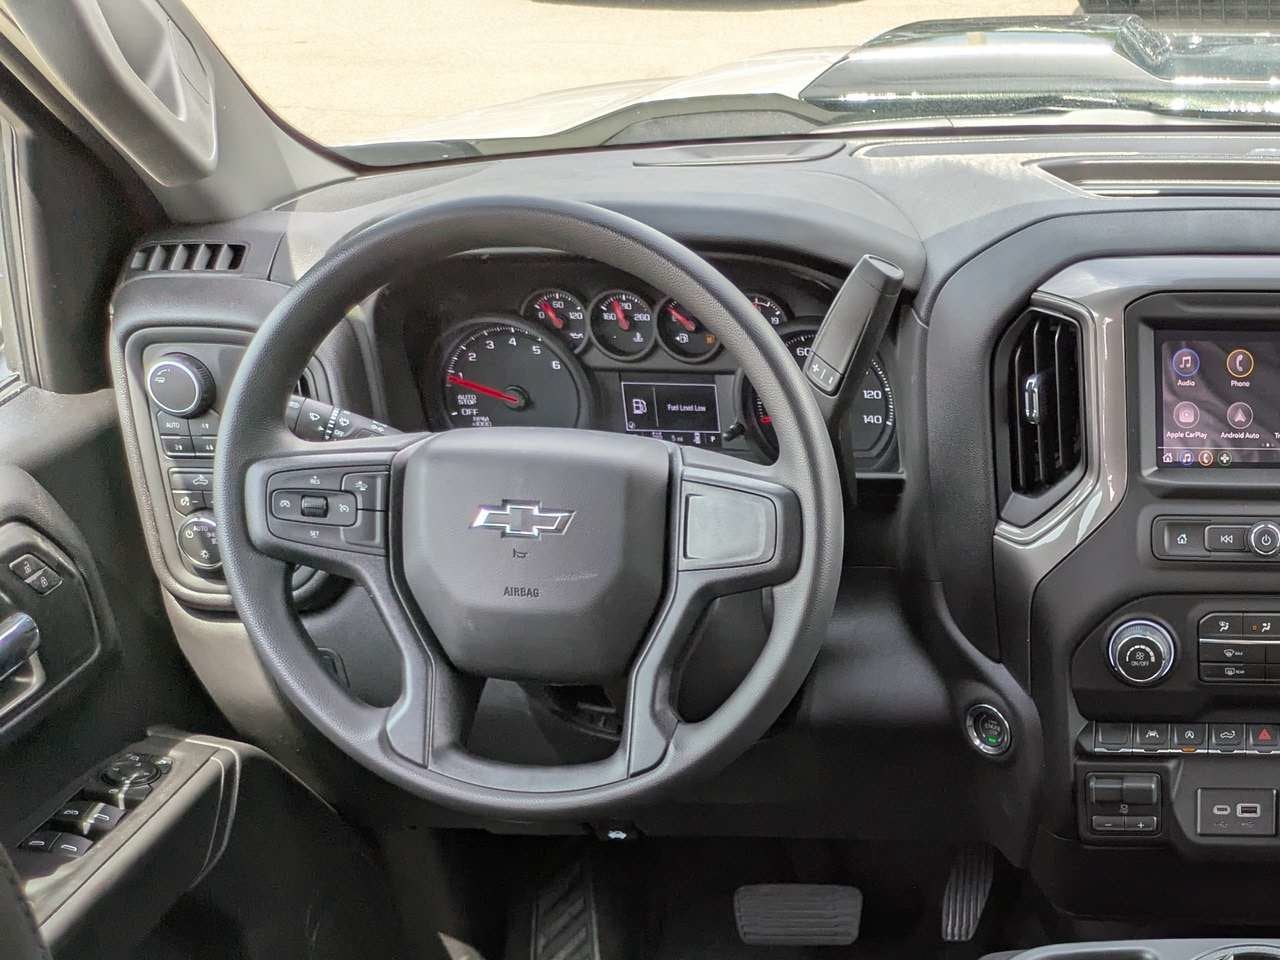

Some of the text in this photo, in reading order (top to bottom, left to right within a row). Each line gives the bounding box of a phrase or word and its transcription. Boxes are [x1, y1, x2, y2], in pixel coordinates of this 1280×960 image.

[569, 312, 583, 320] 120
[486, 340, 495, 349] 3
[508, 337, 517, 346] 4
[532, 345, 541, 355] 5
[468, 352, 477, 362] 2
[552, 361, 561, 370] 6
[1177, 380, 1196, 388] Audio
[1230, 380, 1250, 388] Phone
[863, 390, 882, 399] 120
[863, 415, 882, 424] 140
[1166, 431, 1208, 440] Apple CarPlay
[504, 586, 540, 598] AIRBAG
